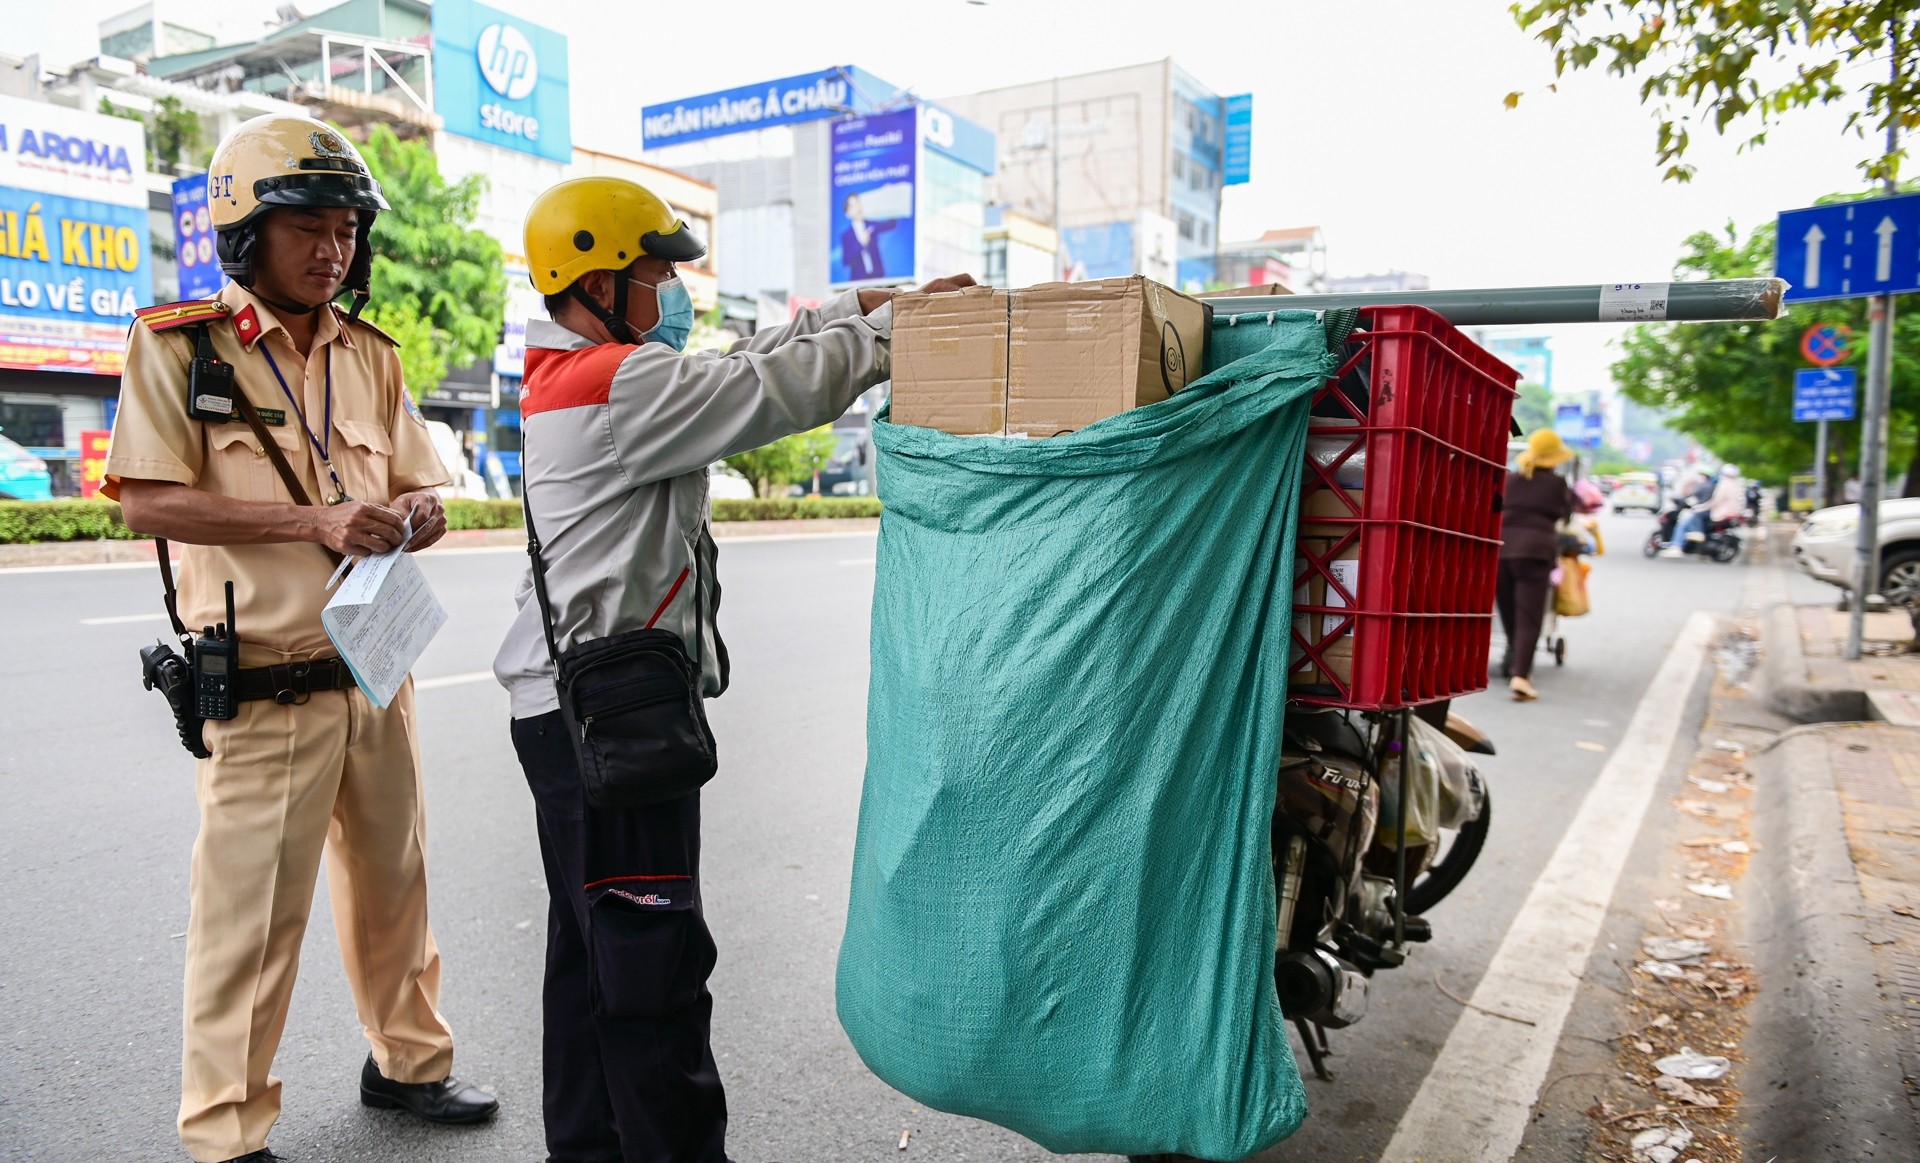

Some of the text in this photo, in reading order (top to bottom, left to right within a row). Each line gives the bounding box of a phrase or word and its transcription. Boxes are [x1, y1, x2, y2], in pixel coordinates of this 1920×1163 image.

[489, 24, 528, 97] hp
[480, 103, 539, 140] store
[644, 78, 847, 139] NGÂN HÀNG Á CHÂU
[18, 128, 132, 174] AROMA
[60, 218, 140, 273] KHO
[1, 278, 40, 308] LO
[90, 286, 139, 317] GIÁ
